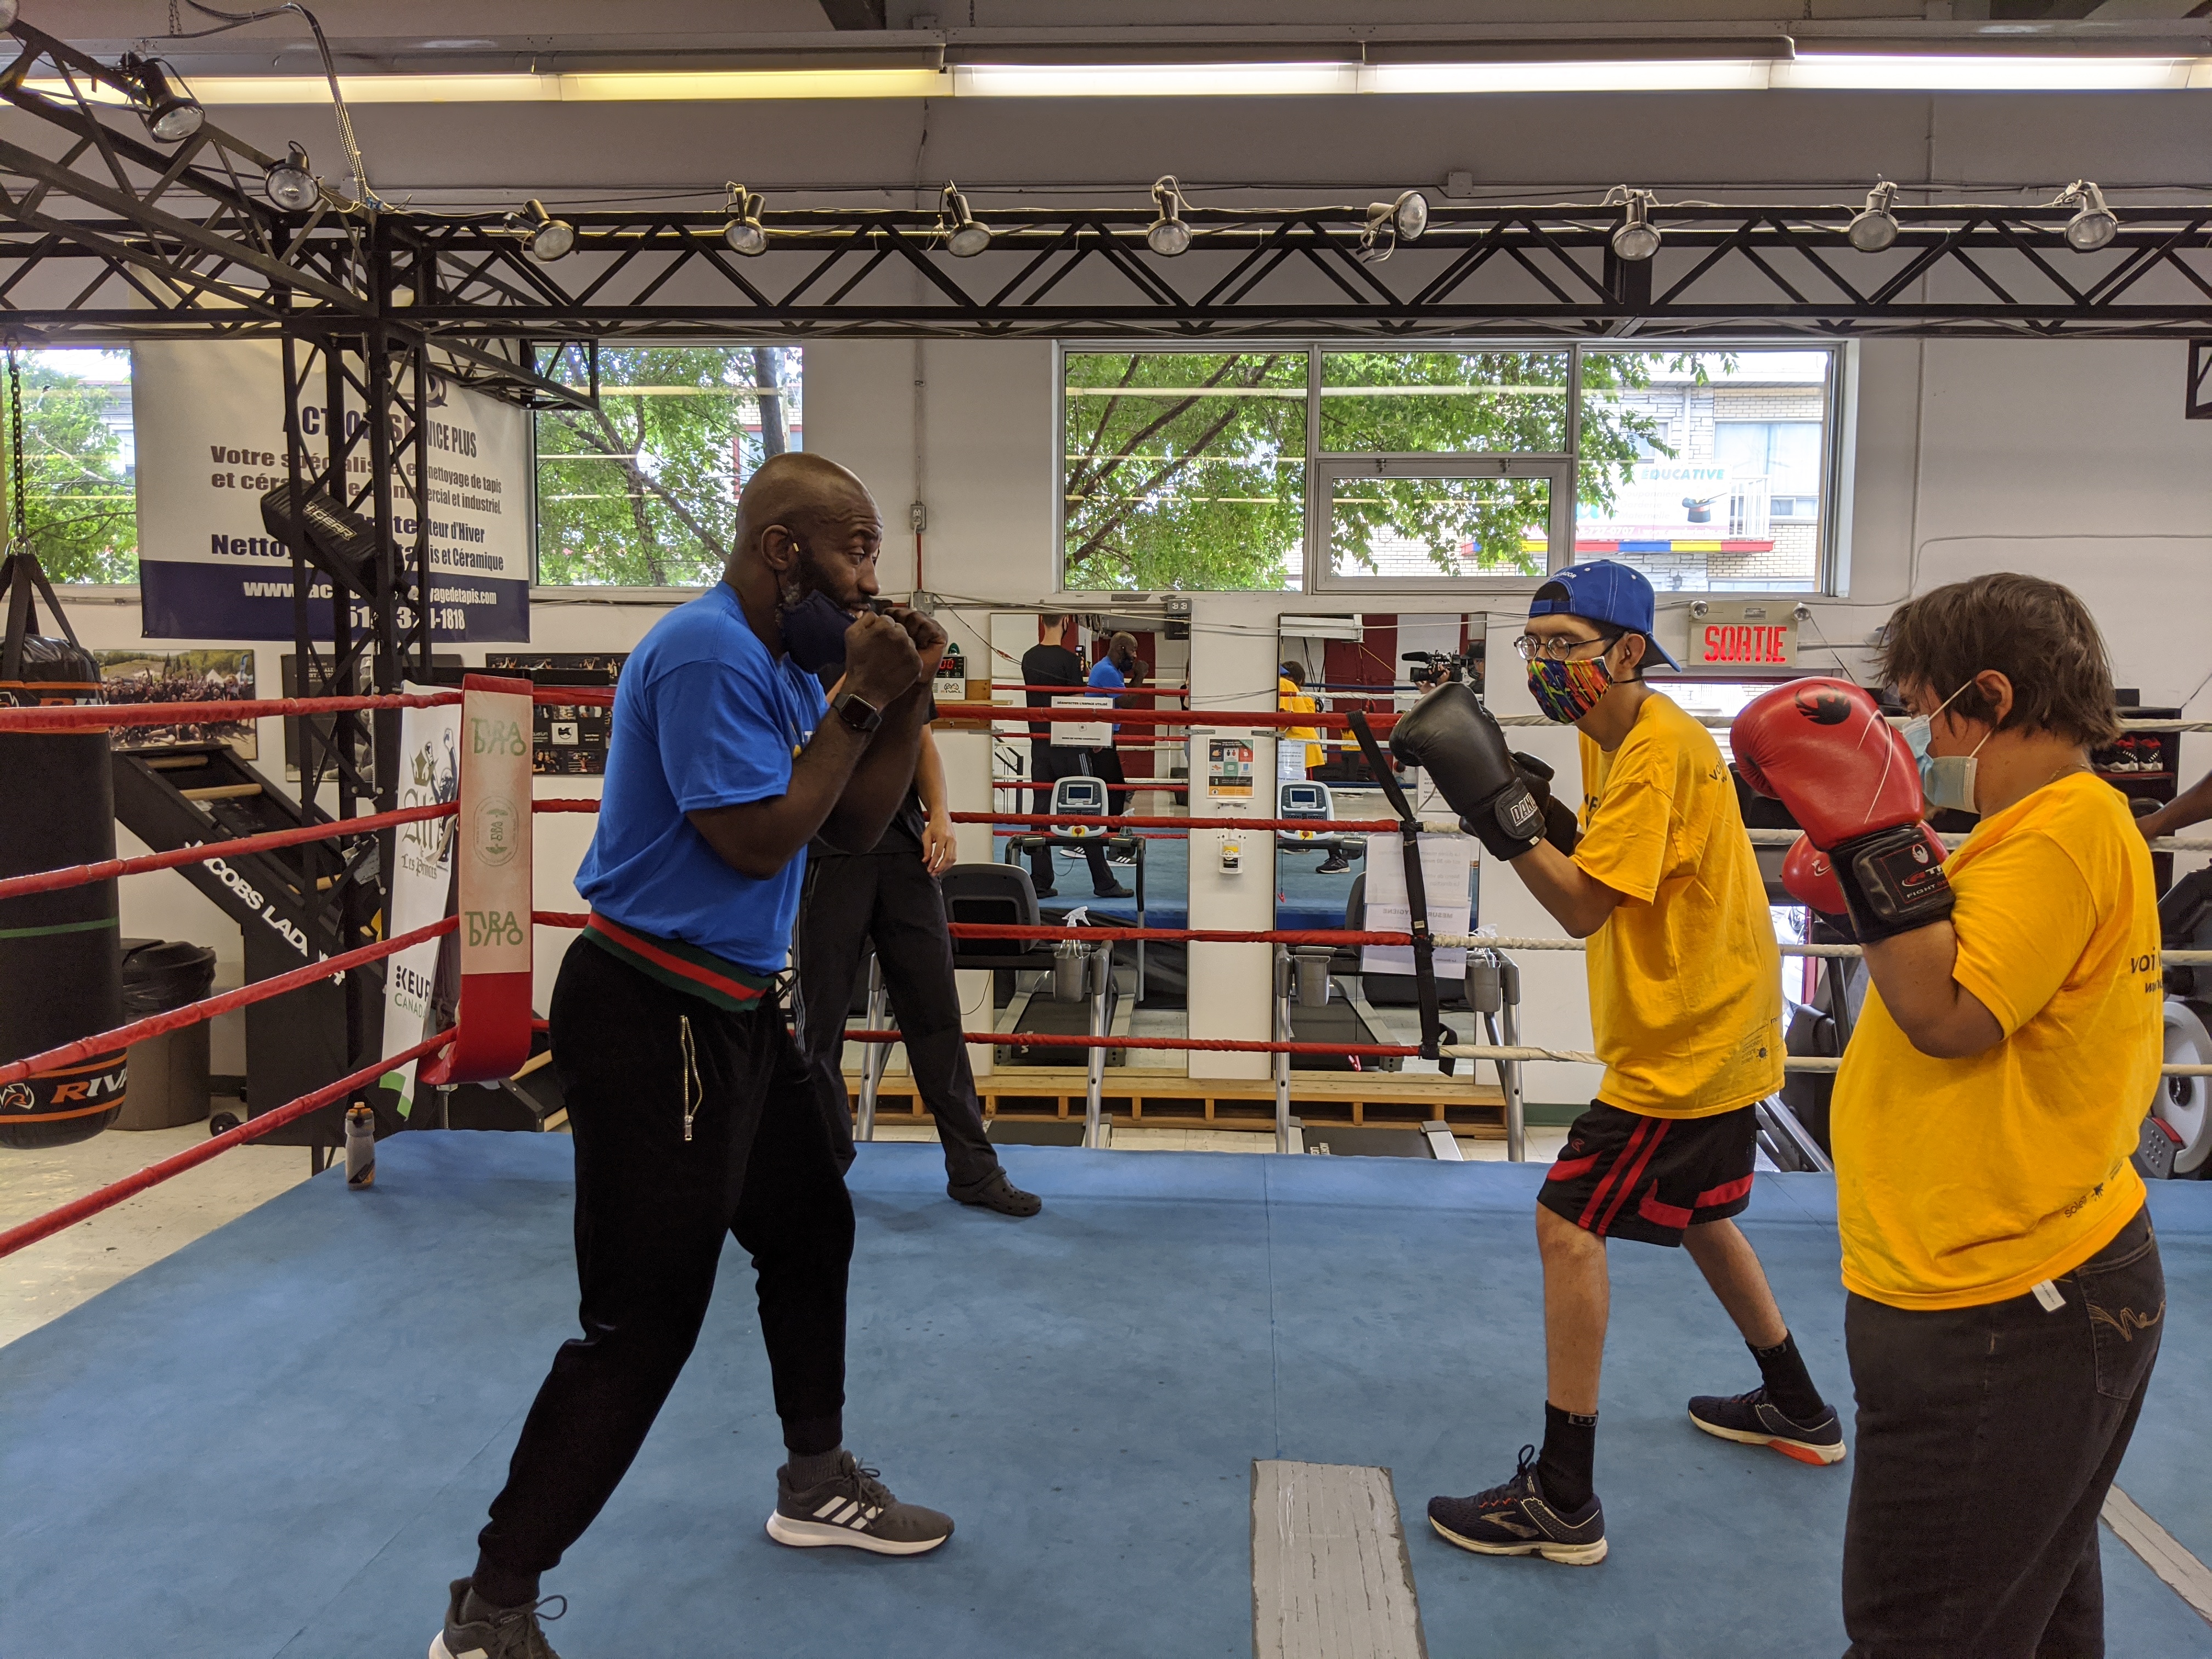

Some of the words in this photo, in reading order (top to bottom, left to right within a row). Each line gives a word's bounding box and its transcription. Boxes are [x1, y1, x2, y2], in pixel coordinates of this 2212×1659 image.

[452, 426, 477, 458] PLUS
[211, 445, 275, 466] Votre
[428, 466, 470, 487] nettoyage
[471, 474, 482, 489] de
[483, 476, 502, 494] tapis
[1641, 467, 1725, 480] ÉDUCATIVE
[212, 473, 235, 488] et
[452, 493, 461, 507] et
[462, 495, 502, 515] industriel.
[451, 522, 485, 543] d'Hiver
[442, 548, 451, 565] et
[453, 548, 504, 571] Céramique
[1704, 625, 1787, 663] SORTIE
[401, 853, 415, 871] Les
[1906, 884, 1936, 898] FIGHT
